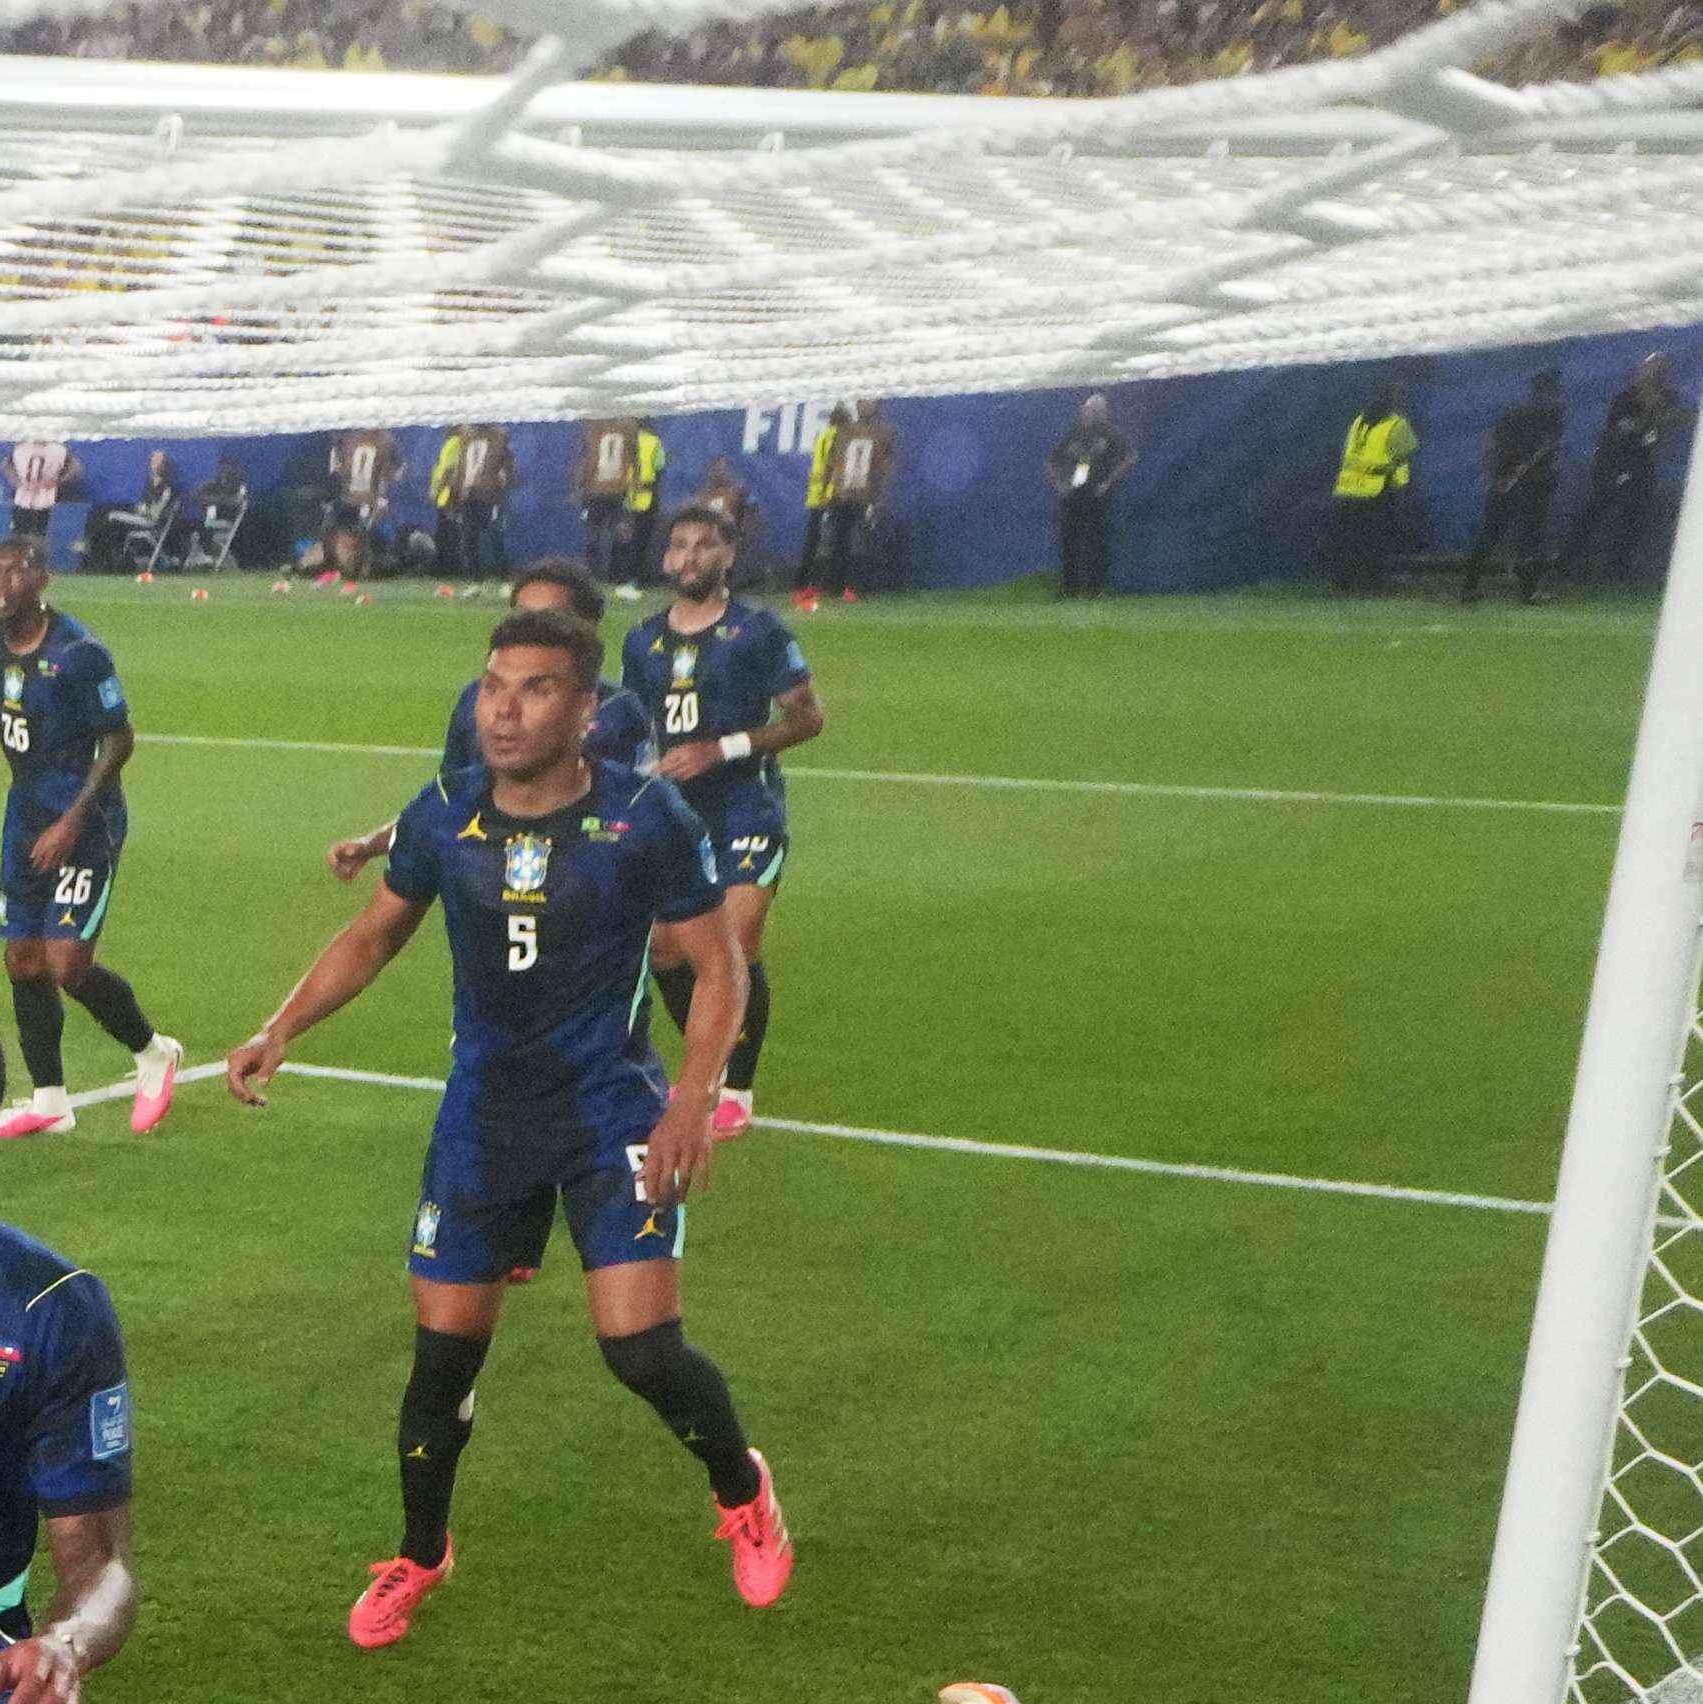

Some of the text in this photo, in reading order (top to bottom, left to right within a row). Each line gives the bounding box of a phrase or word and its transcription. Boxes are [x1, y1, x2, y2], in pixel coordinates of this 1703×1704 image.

[742, 400, 833, 454] FIF
[1, 712, 30, 753] 26
[665, 691, 699, 734] 20
[55, 866, 93, 905] 26
[507, 914, 538, 972] 5
